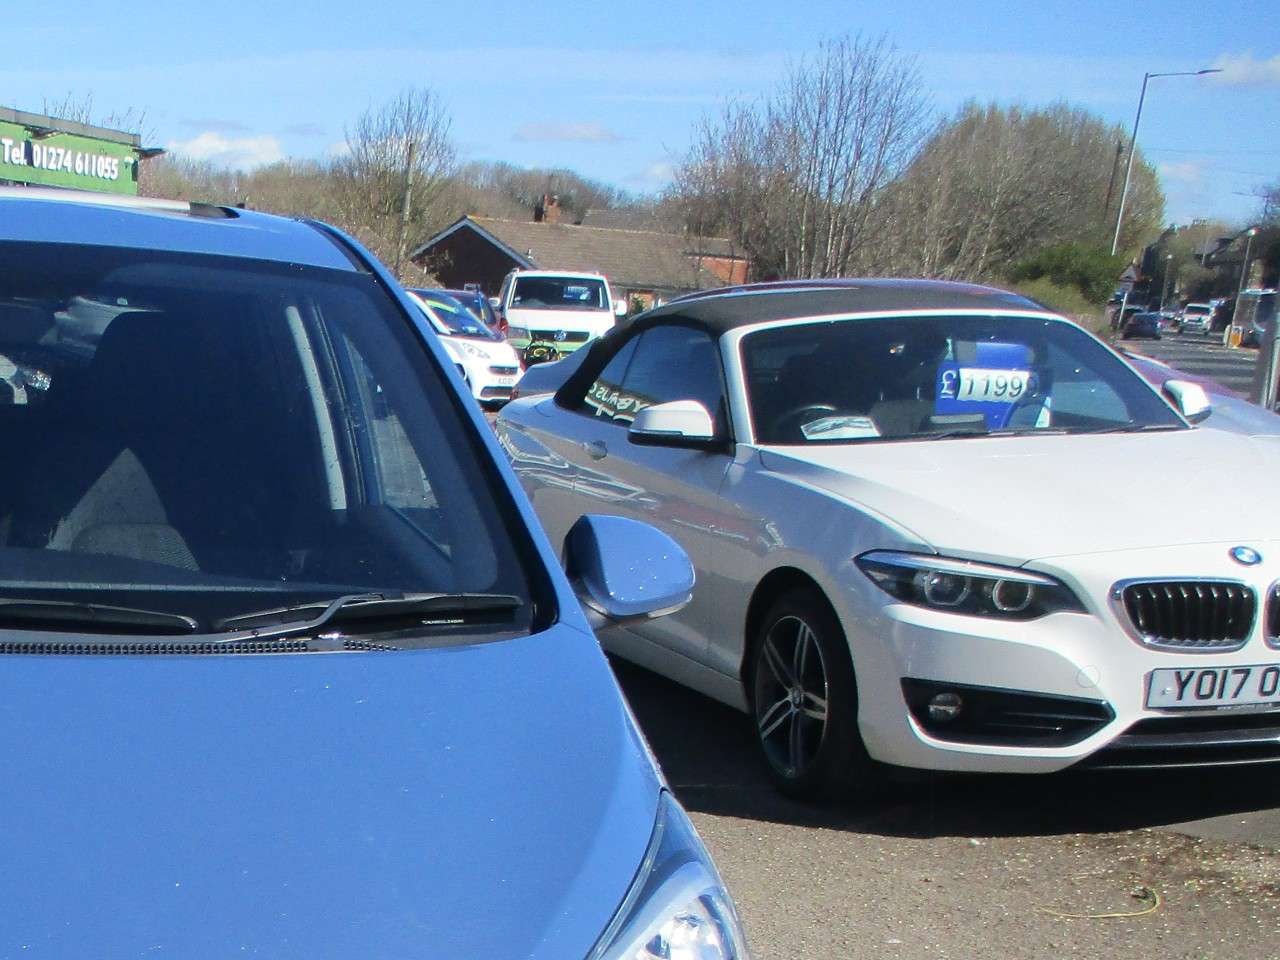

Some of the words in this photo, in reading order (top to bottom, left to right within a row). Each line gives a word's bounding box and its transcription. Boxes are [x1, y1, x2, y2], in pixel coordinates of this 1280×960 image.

[32, 143, 73, 172] 01274
[74, 152, 119, 180] 611055
[965, 374, 1029, 398] 1199
[1173, 668, 1252, 701] YO17
